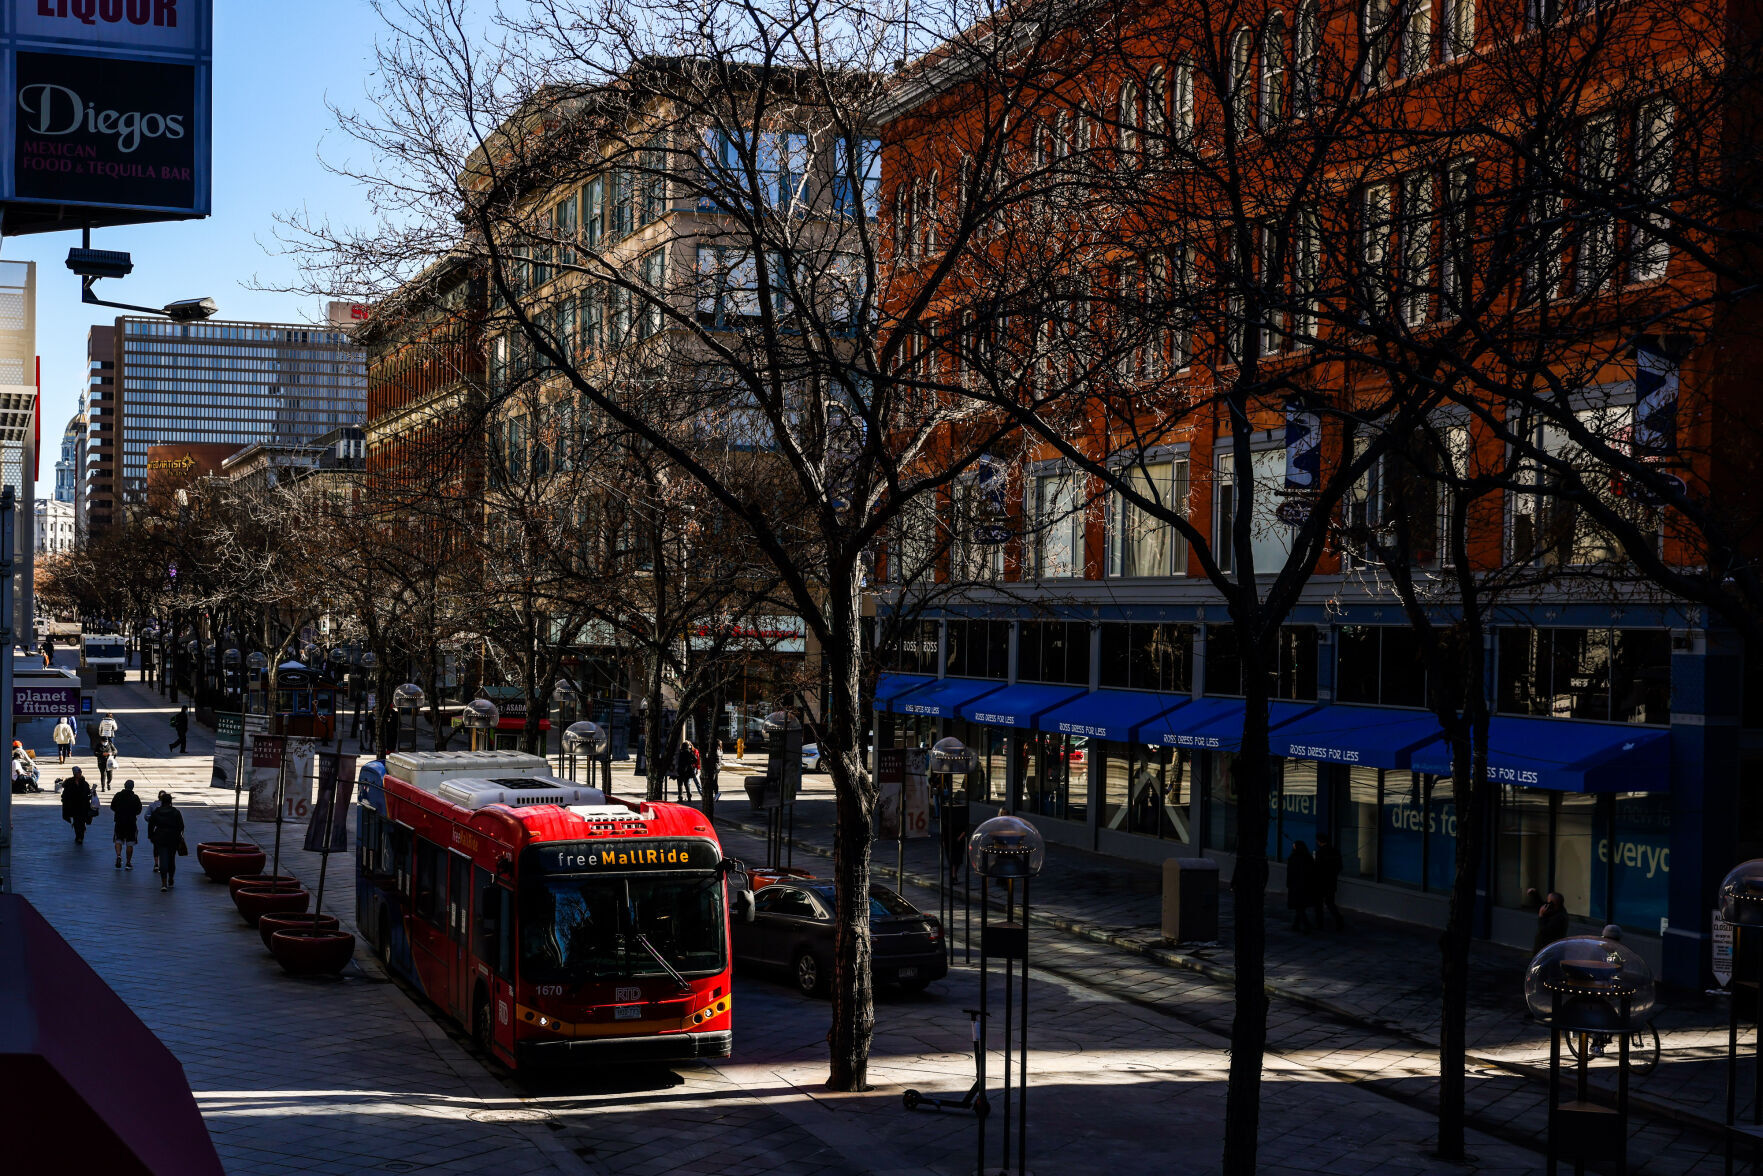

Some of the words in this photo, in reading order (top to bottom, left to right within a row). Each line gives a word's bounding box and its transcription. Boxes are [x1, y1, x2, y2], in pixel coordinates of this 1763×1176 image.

[18, 83, 184, 153] Diegos
[24, 140, 97, 158] MEXICAN
[24, 157, 72, 173] FOOD
[75, 163, 84, 174] &
[88, 161, 157, 179] TEQUILA
[161, 166, 192, 181] BAR
[16, 689, 67, 704] planet
[22, 701, 76, 713] fitness
[1058, 722, 1071, 732] ROSS
[1071, 723, 1085, 734] DRESS
[1085, 725, 1095, 736] FOR
[1095, 727, 1107, 737] LESS
[1163, 733, 1177, 744] ROSS
[1177, 735, 1194, 746] DRESS
[1194, 736, 1206, 747] FOR
[1206, 738, 1219, 748] LESS
[1289, 744, 1306, 756] ROSS
[1307, 746, 1327, 758] DRESS
[1328, 748, 1341, 760] FOR
[1343, 750, 1359, 762] LESS
[1499, 768, 1515, 781] FOR
[1517, 770, 1538, 784] LESS
[286, 797, 308, 817] 16
[908, 811, 927, 831] 16
[1392, 803, 1436, 833] dress
[558, 852, 598, 867] free
[602, 849, 689, 865] MallRide
[536, 985, 563, 996] 1670
[615, 986, 642, 1001] RTD
